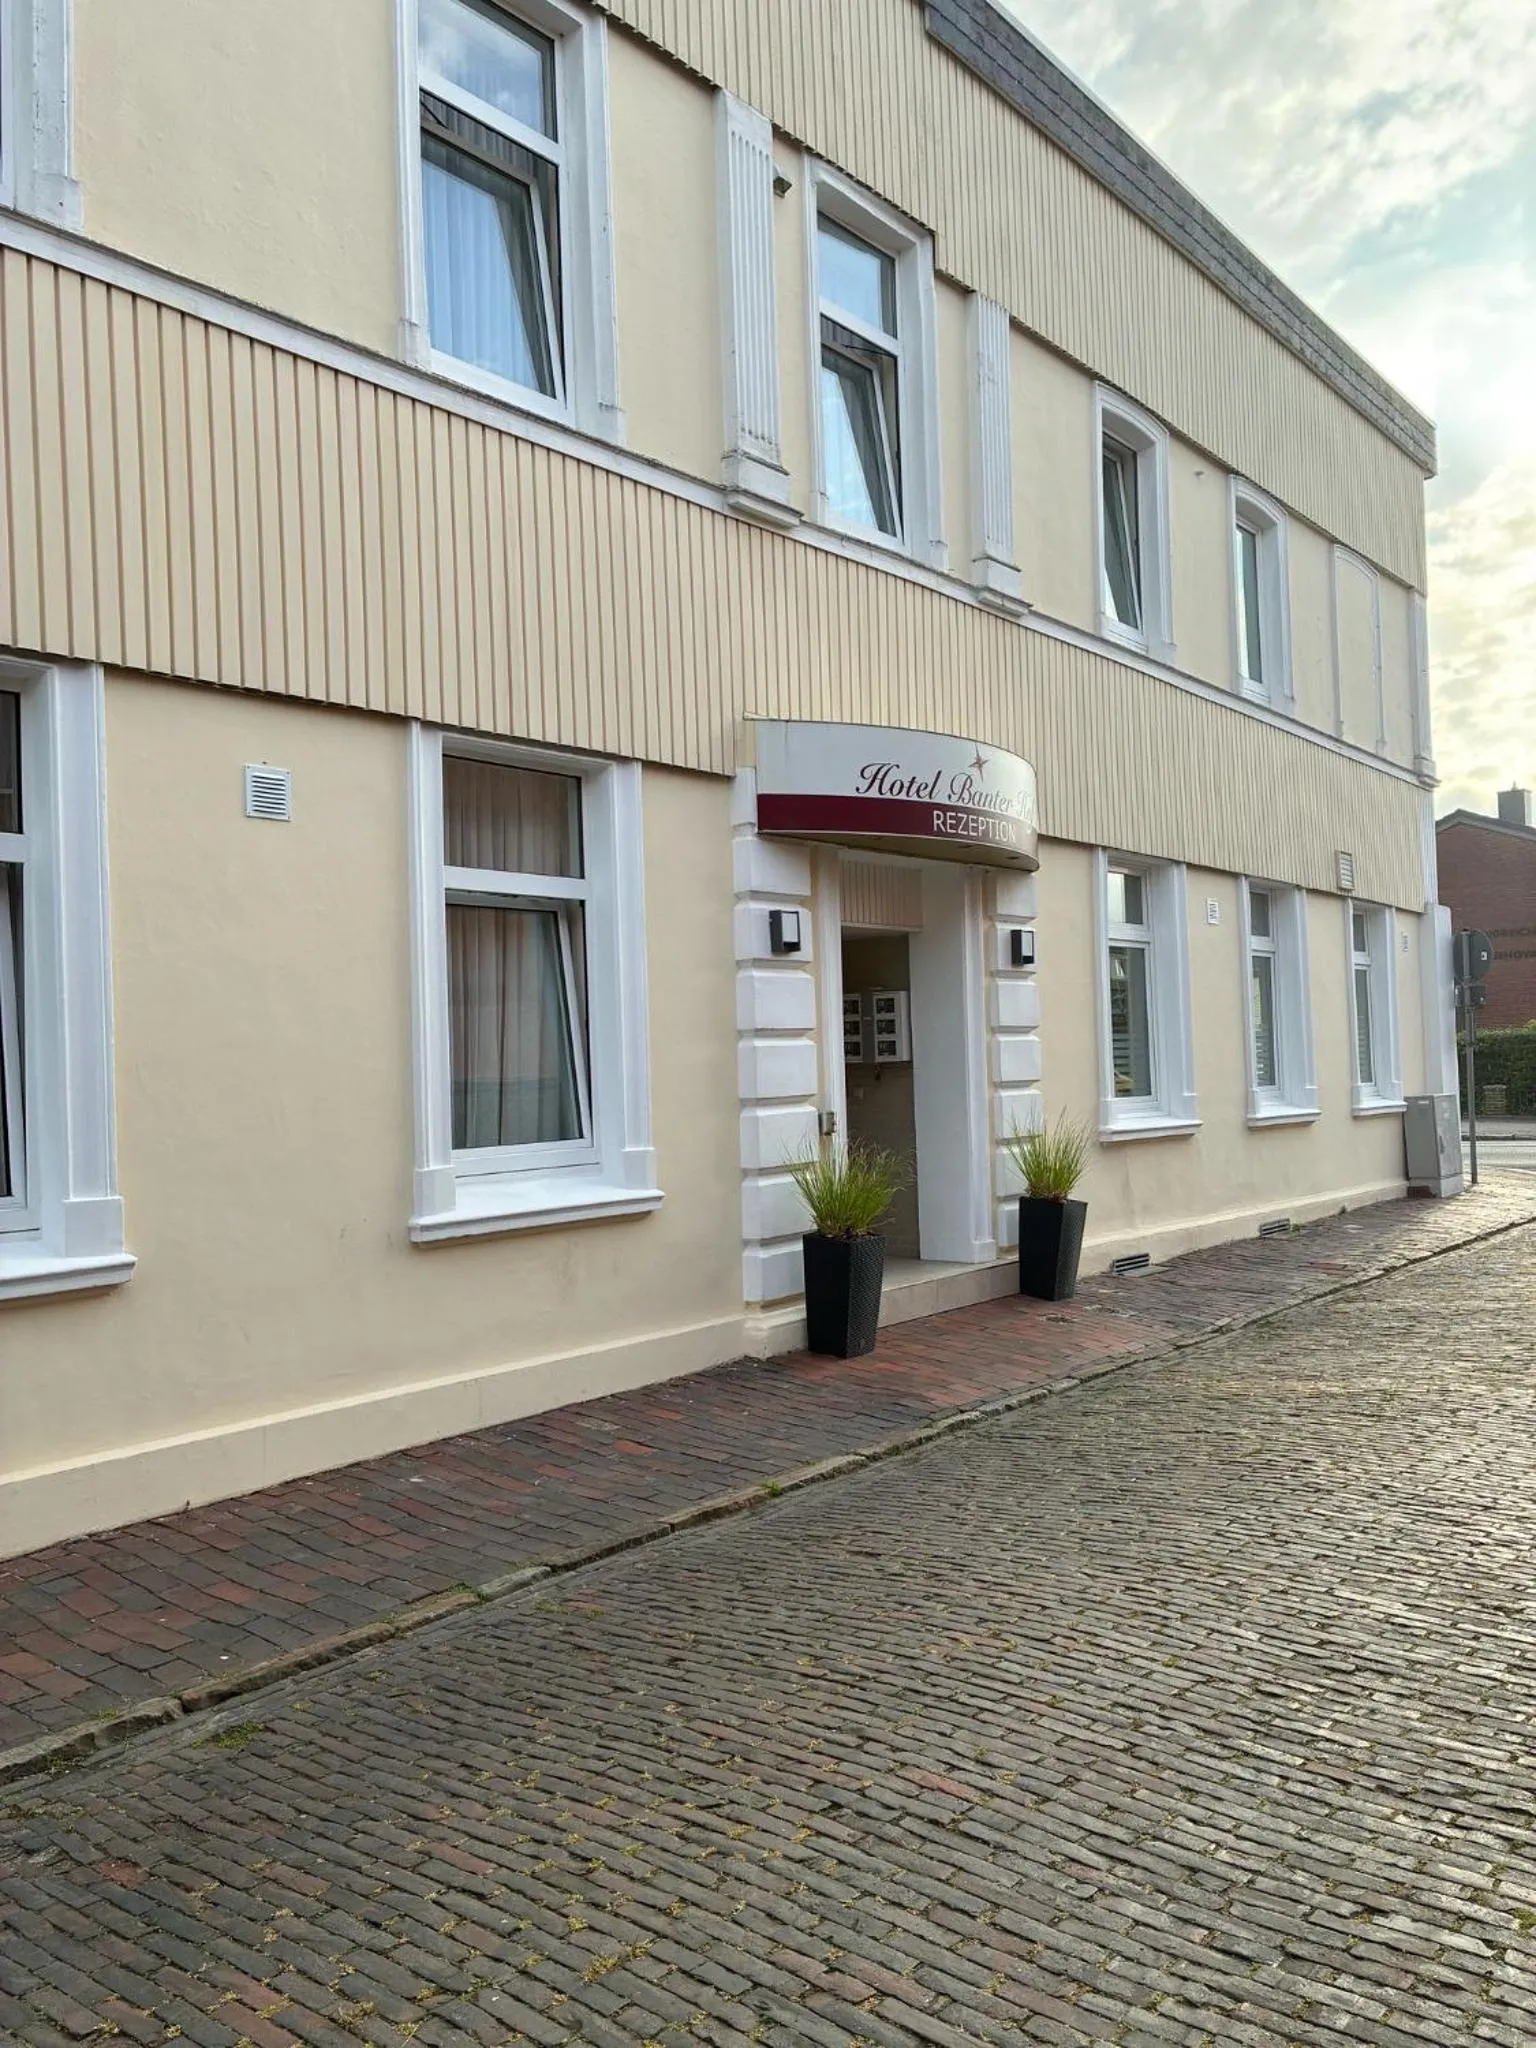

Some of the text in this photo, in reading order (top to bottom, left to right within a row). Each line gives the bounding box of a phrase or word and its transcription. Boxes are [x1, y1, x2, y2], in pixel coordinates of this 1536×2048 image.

[856, 762, 942, 800] Hotel
[948, 772, 1014, 813] Banter
[933, 810, 1017, 843] REZEPTION
